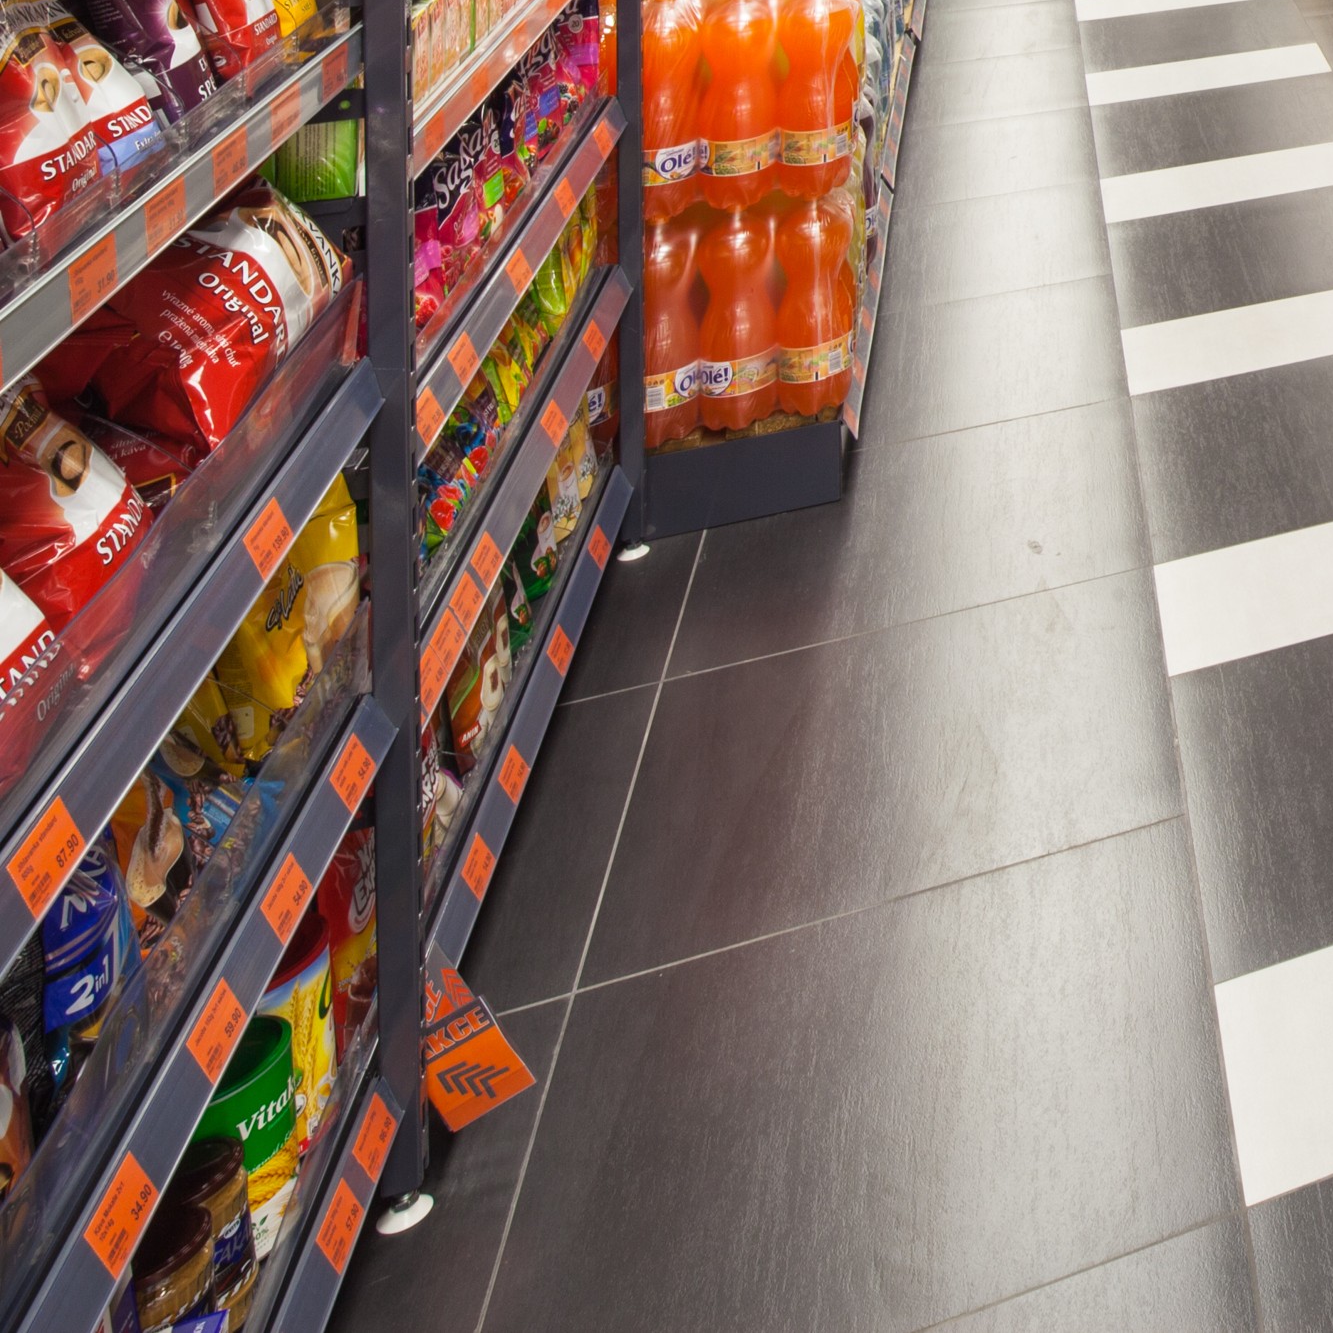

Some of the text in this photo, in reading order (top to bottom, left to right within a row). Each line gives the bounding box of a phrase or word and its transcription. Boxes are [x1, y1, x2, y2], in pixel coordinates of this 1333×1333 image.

[198, 271, 271, 345] Original
[55, 833, 79, 868] 87.90
[130, 1183, 152, 1222] 34.90
